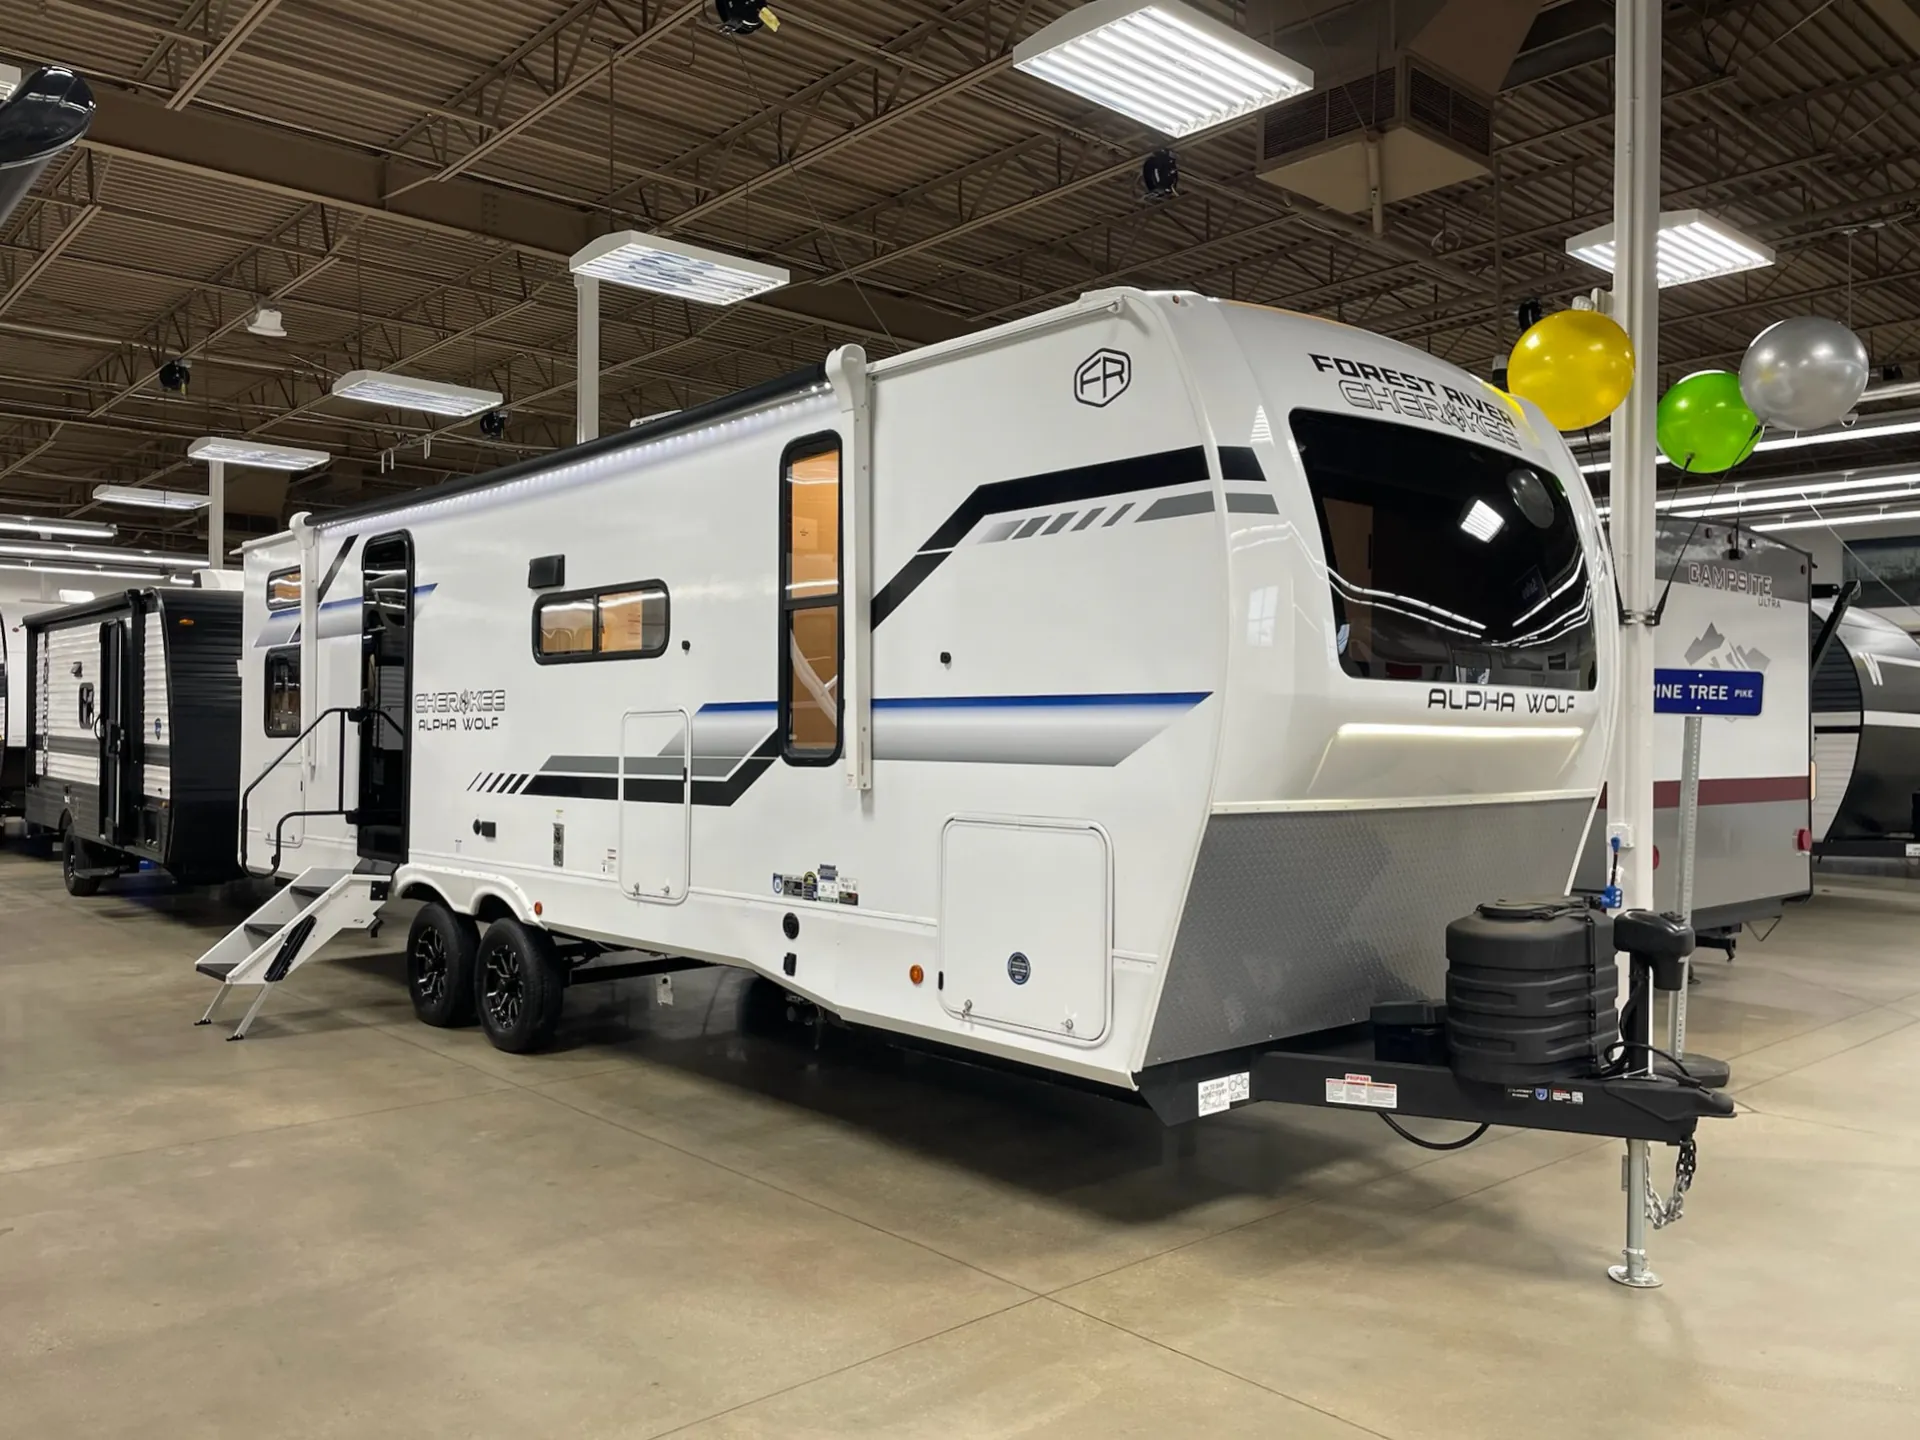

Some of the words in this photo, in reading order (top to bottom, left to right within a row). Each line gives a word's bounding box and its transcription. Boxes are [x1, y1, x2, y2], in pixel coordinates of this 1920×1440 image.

[1308, 353, 1437, 396] FOREST
[1440, 383, 1516, 428] RIVER
[1688, 562, 1773, 596] CAMPSITE
[1758, 597, 1781, 609] ULTRA
[415, 689, 506, 714] CHEROKEE
[1427, 688, 1515, 712] ALPHA
[1526, 693, 1575, 714] WOLF
[1654, 684, 1683, 699] INE
[1689, 685, 1729, 701] TREE
[1734, 689, 1754, 698] PIKE
[418, 718, 457, 731] ALPHA
[463, 717, 499, 731] WOLF
